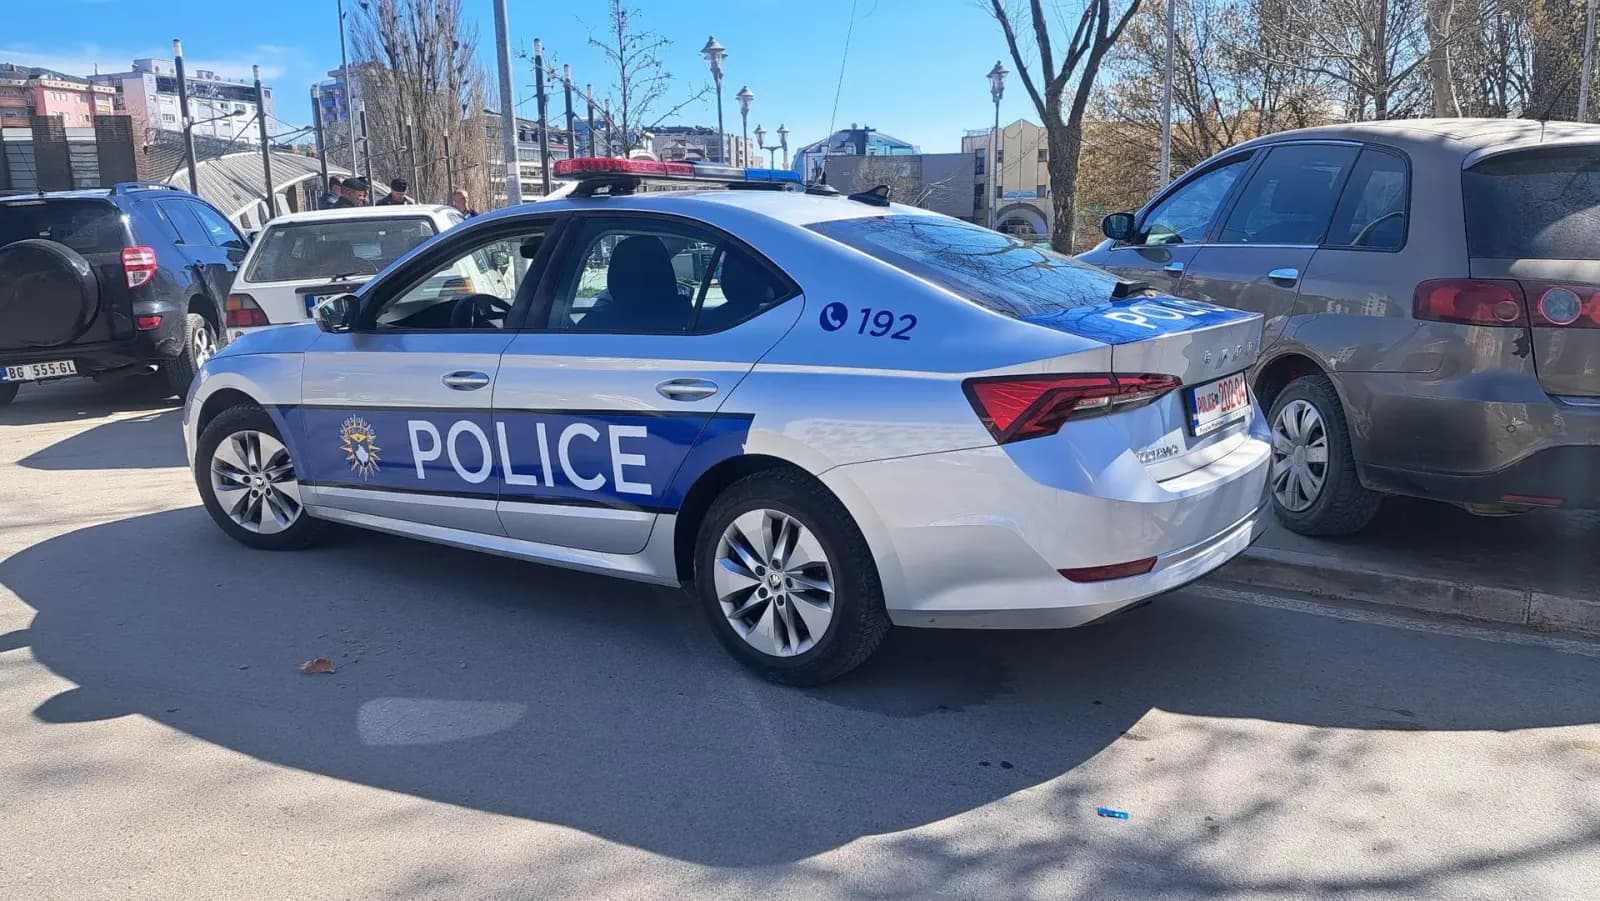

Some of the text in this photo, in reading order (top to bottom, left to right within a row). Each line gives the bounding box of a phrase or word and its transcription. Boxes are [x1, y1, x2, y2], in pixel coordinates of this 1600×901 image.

[857, 307, 918, 341] 192
[8, 366, 24, 379] BG
[407, 418, 653, 497] POLICE
